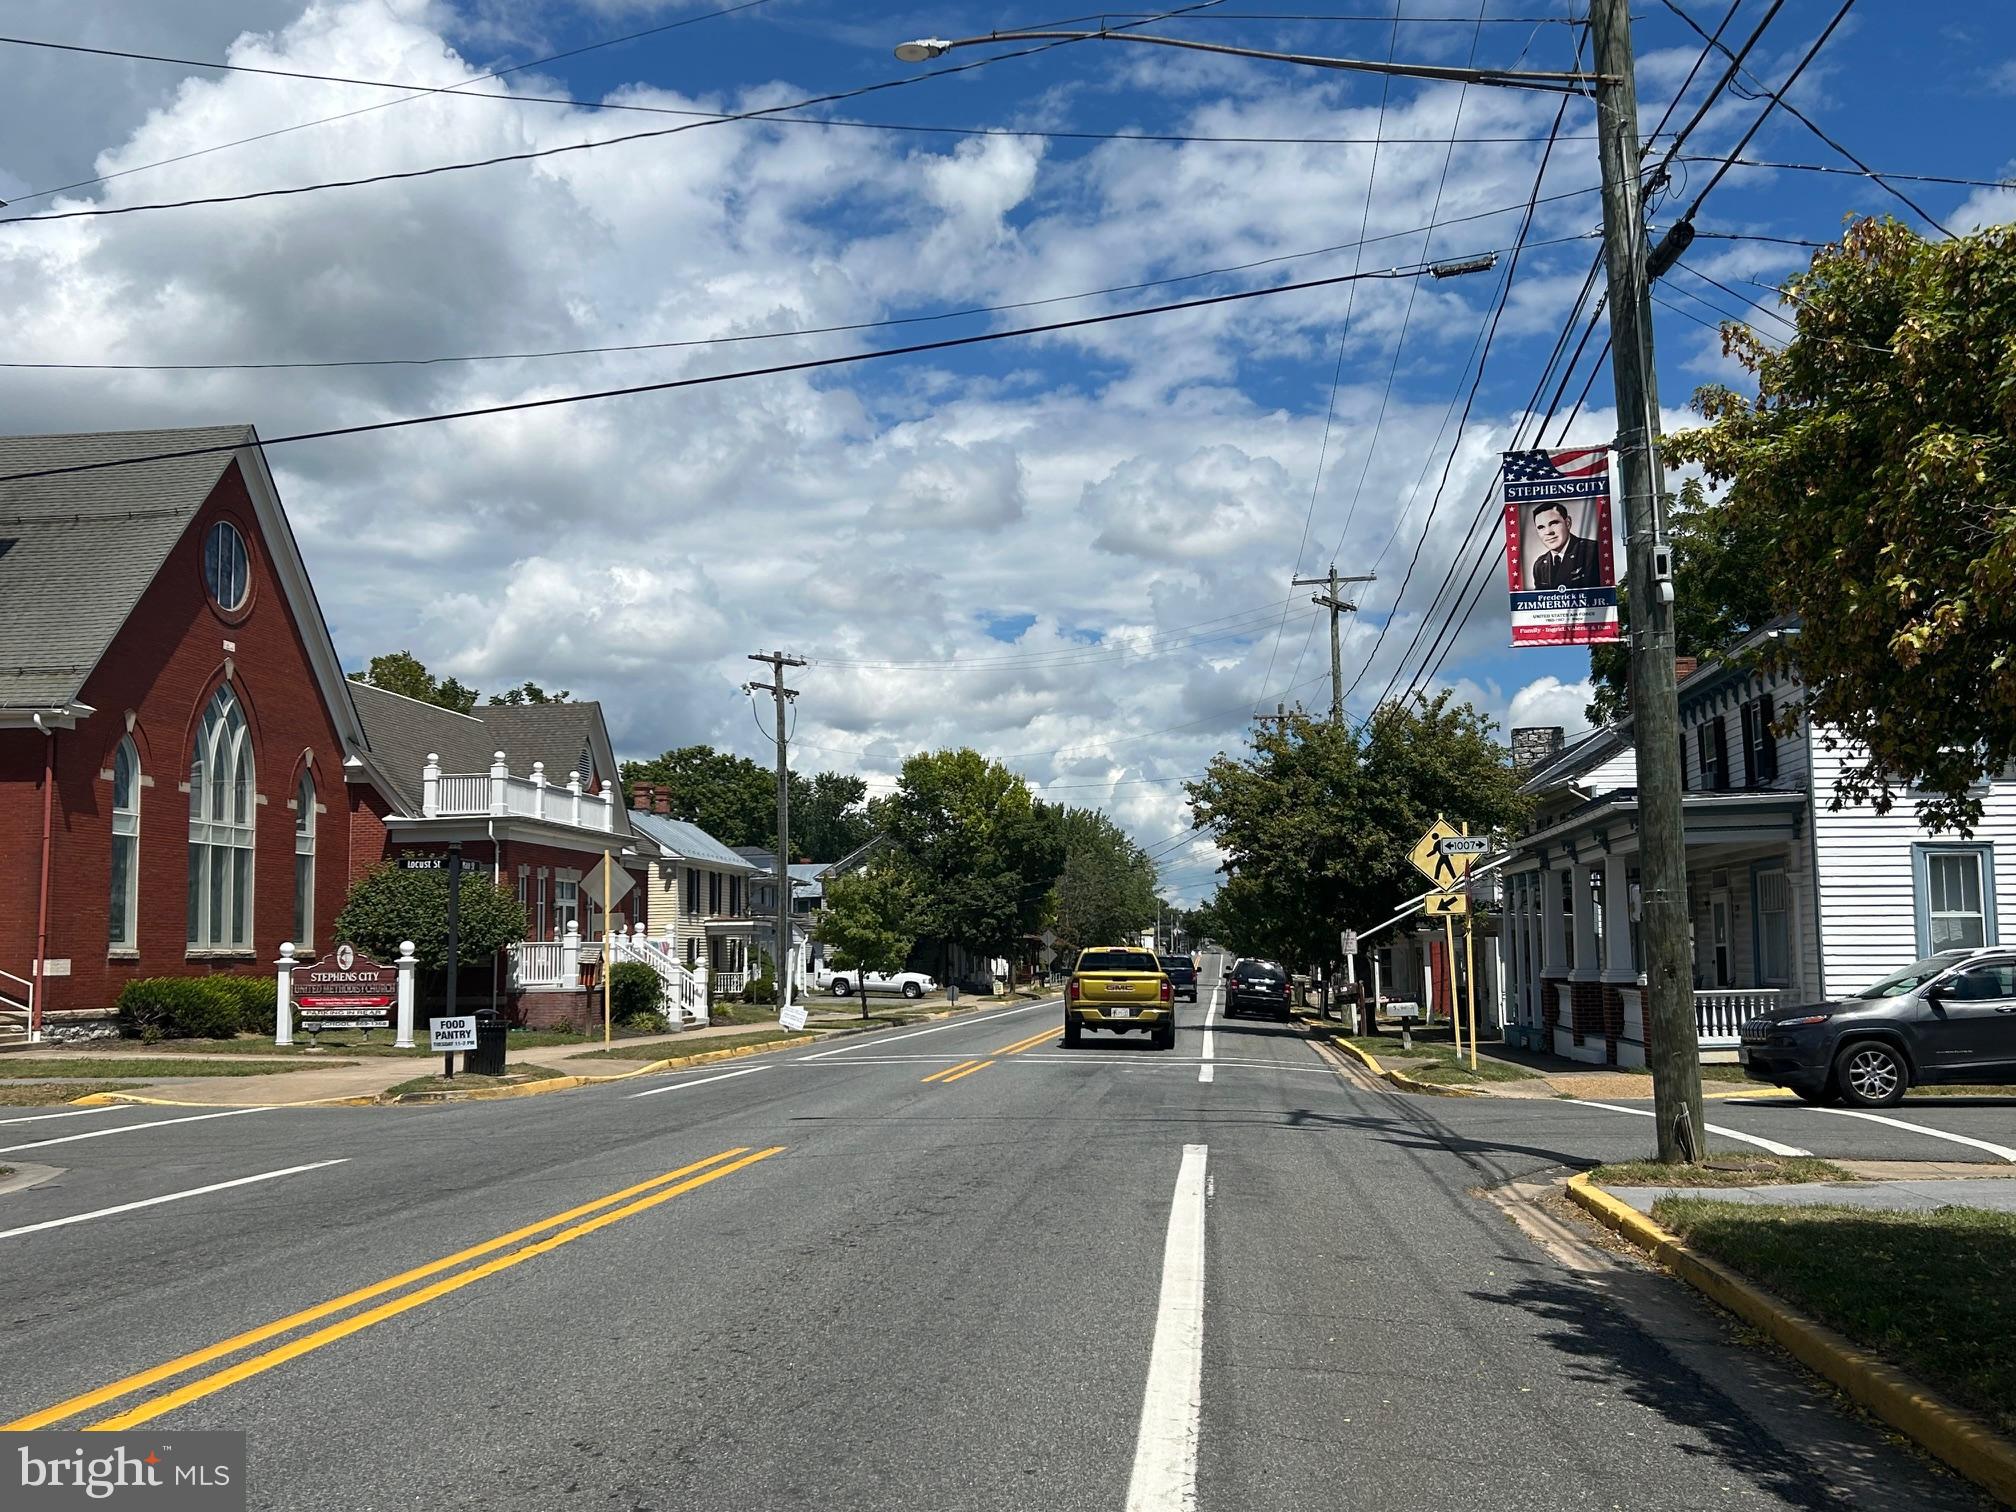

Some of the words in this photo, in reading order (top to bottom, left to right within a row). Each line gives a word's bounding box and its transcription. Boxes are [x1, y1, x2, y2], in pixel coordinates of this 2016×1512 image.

[1508, 483, 1574, 497] STEPHENS
[1576, 480, 1605, 493] CITY
[1537, 593, 1576, 601] Frederick
[1592, 597, 1609, 606] JR.
[1454, 840, 1476, 850] 1007
[311, 972, 356, 982] STEPHENS
[358, 972, 379, 981] CITY
[294, 984, 321, 993] UNITED
[323, 984, 365, 993] METHODIST
[365, 983, 395, 993] CHURCH
[440, 1020, 465, 1029] FOOD
[435, 1030, 471, 1040] PANTRY
